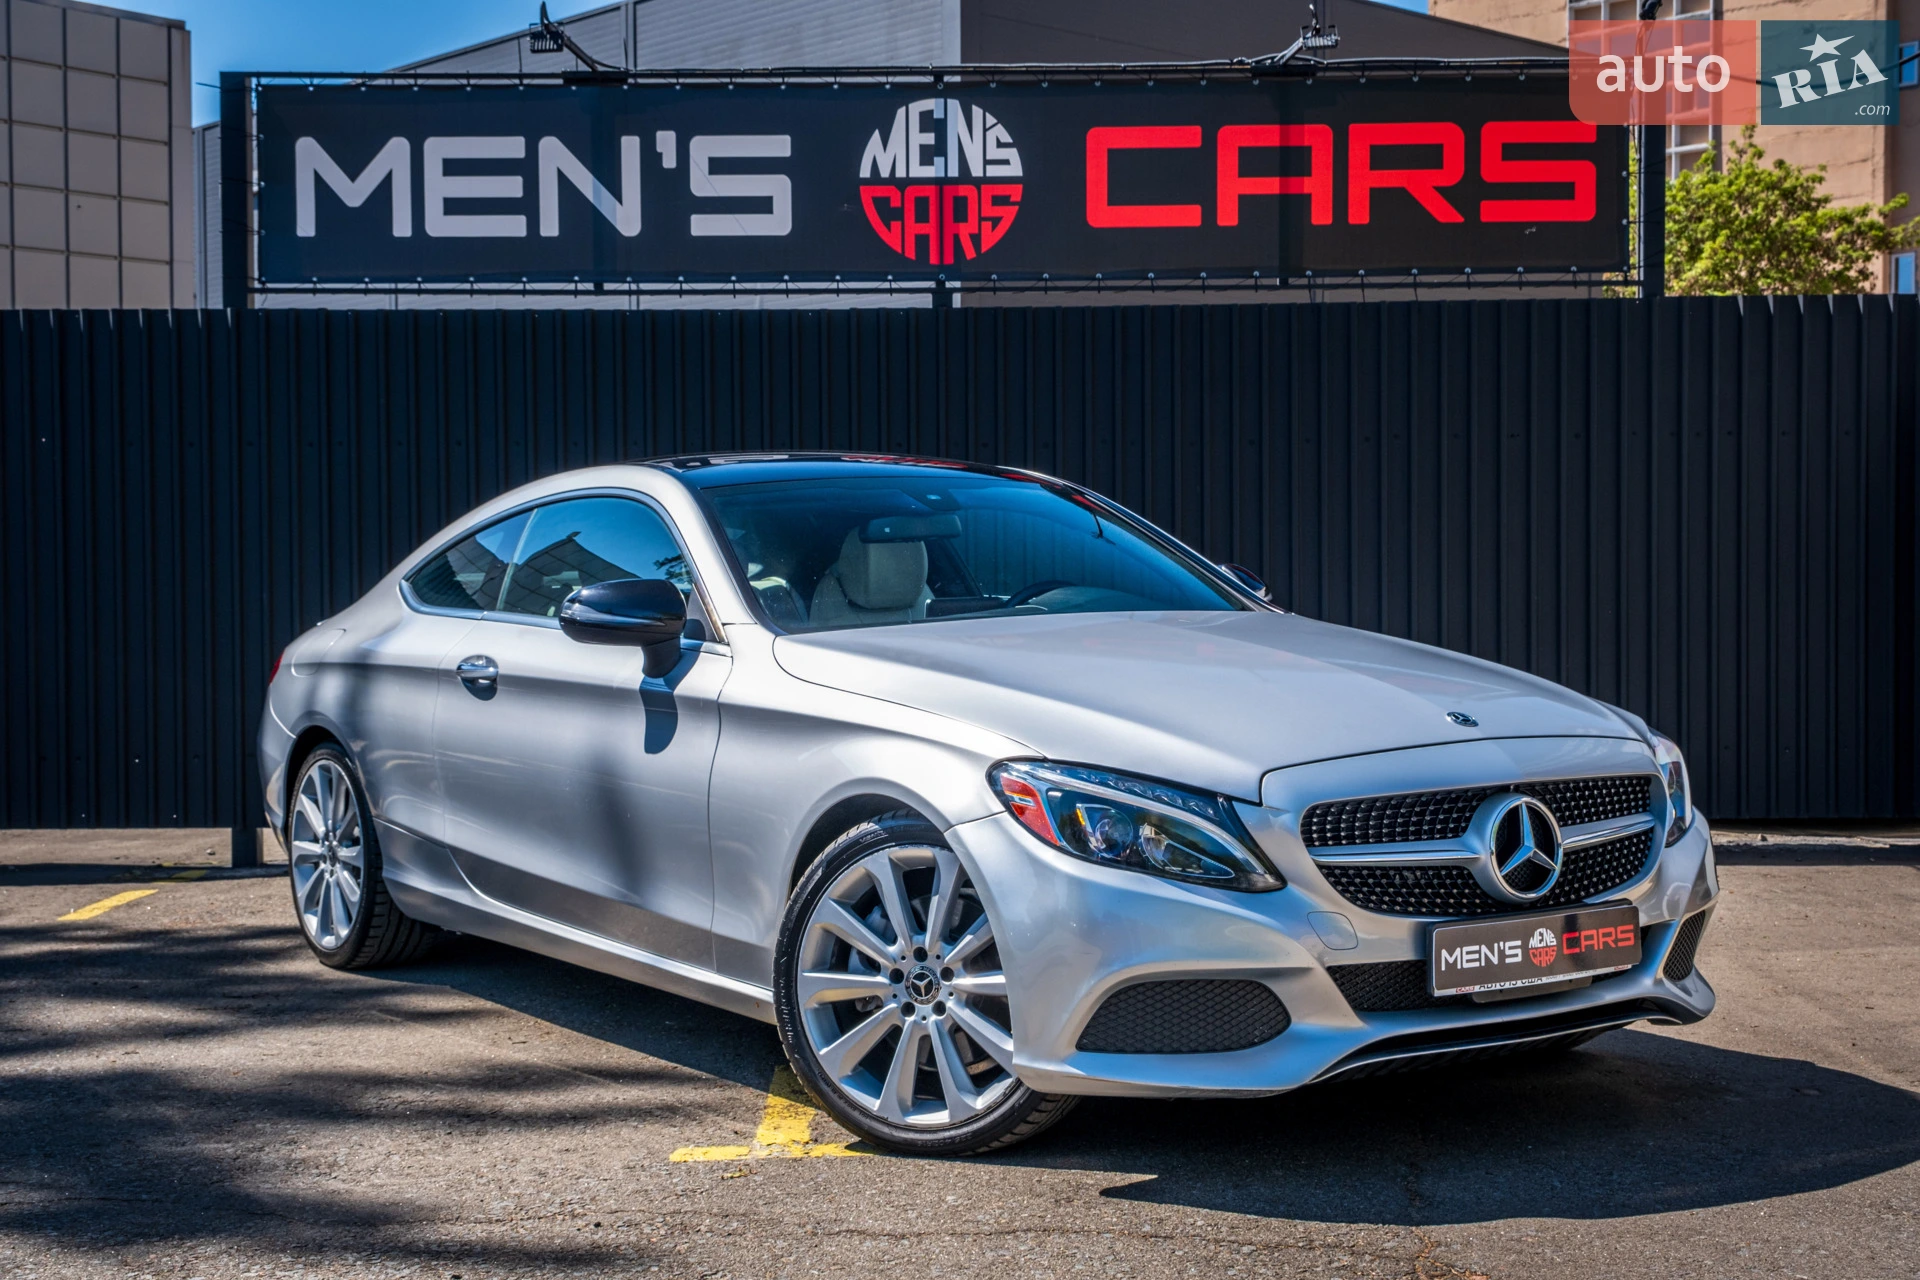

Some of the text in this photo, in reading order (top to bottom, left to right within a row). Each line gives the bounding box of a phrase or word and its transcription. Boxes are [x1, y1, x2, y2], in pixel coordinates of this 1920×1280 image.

[859, 98, 1023, 178] MEN'S
[295, 121, 1597, 237] MEN'S CARS
[859, 184, 1023, 265] CARS
[1441, 924, 1635, 971] MEN'S CARS
[1529, 946, 1557, 967] CARS
